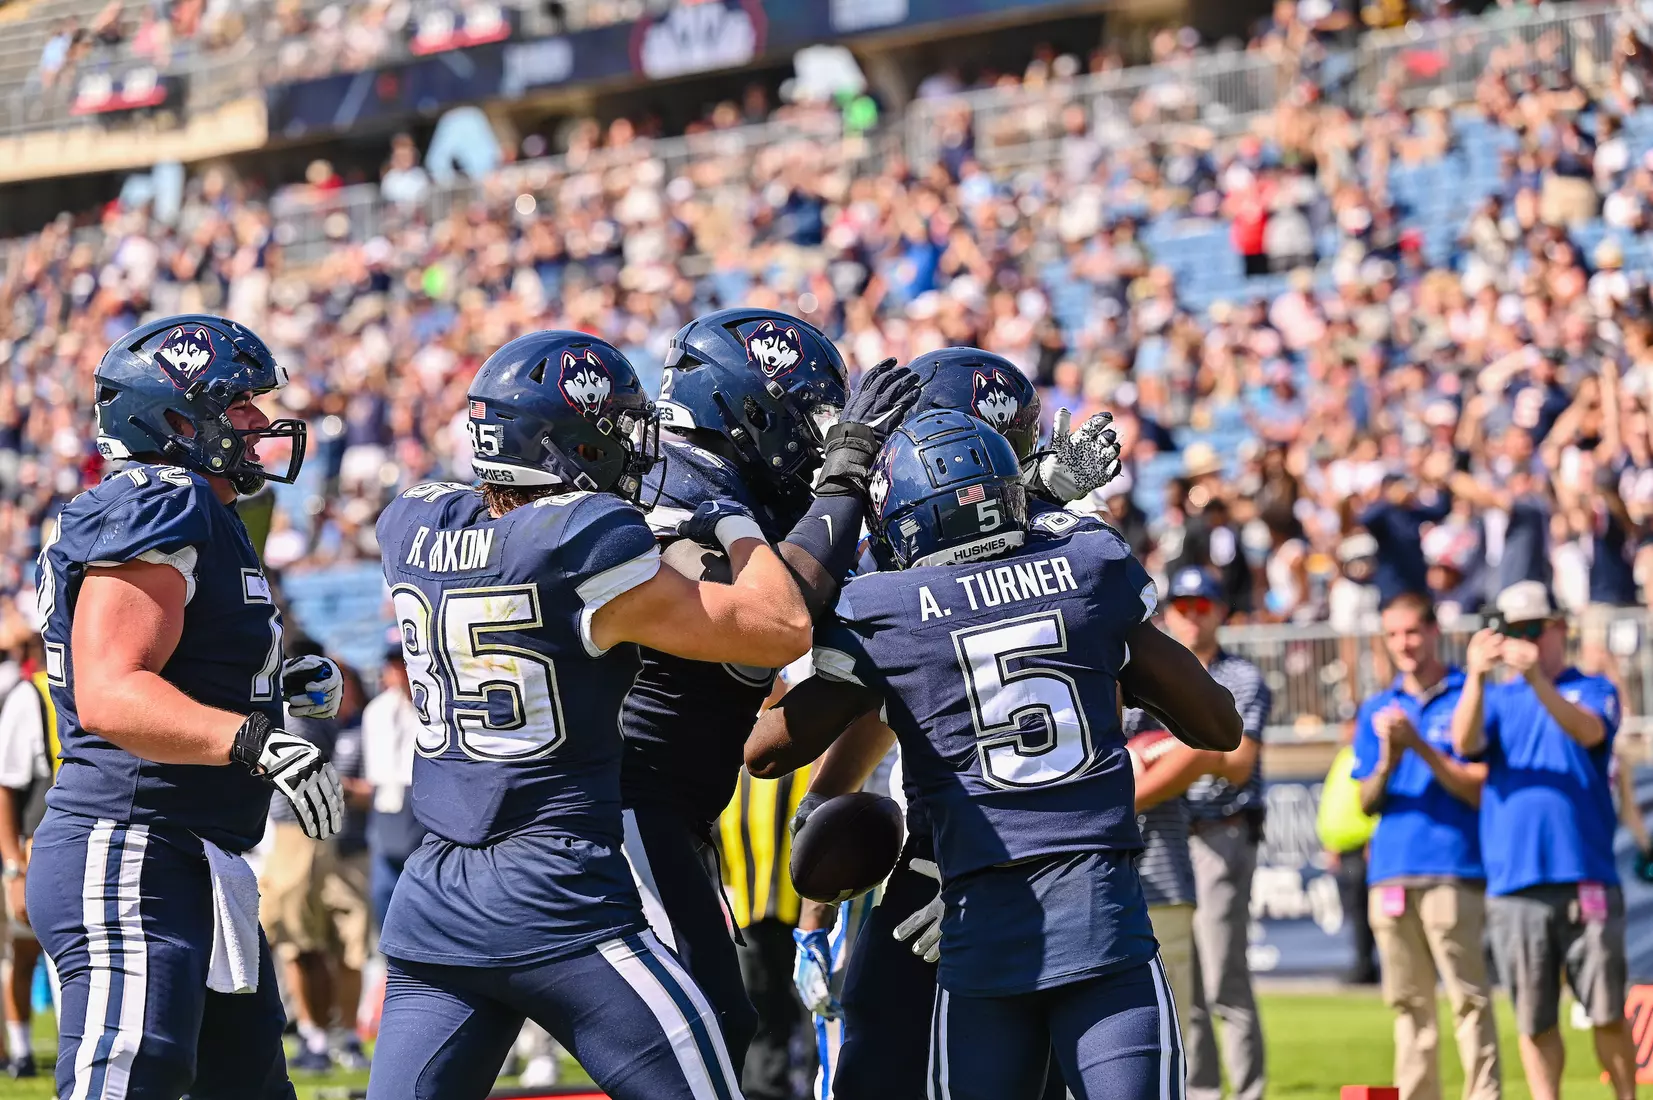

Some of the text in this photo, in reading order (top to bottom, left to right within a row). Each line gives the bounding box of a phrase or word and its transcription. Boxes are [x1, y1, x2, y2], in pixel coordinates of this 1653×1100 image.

[405, 526, 425, 568] R.
[976, 498, 1001, 533] 5
[953, 538, 1006, 561] HUSKIES
[918, 556, 1079, 622] A. TURNER
[240, 567, 284, 702] 7
[391, 582, 567, 762] 85
[950, 608, 1096, 790] 5
